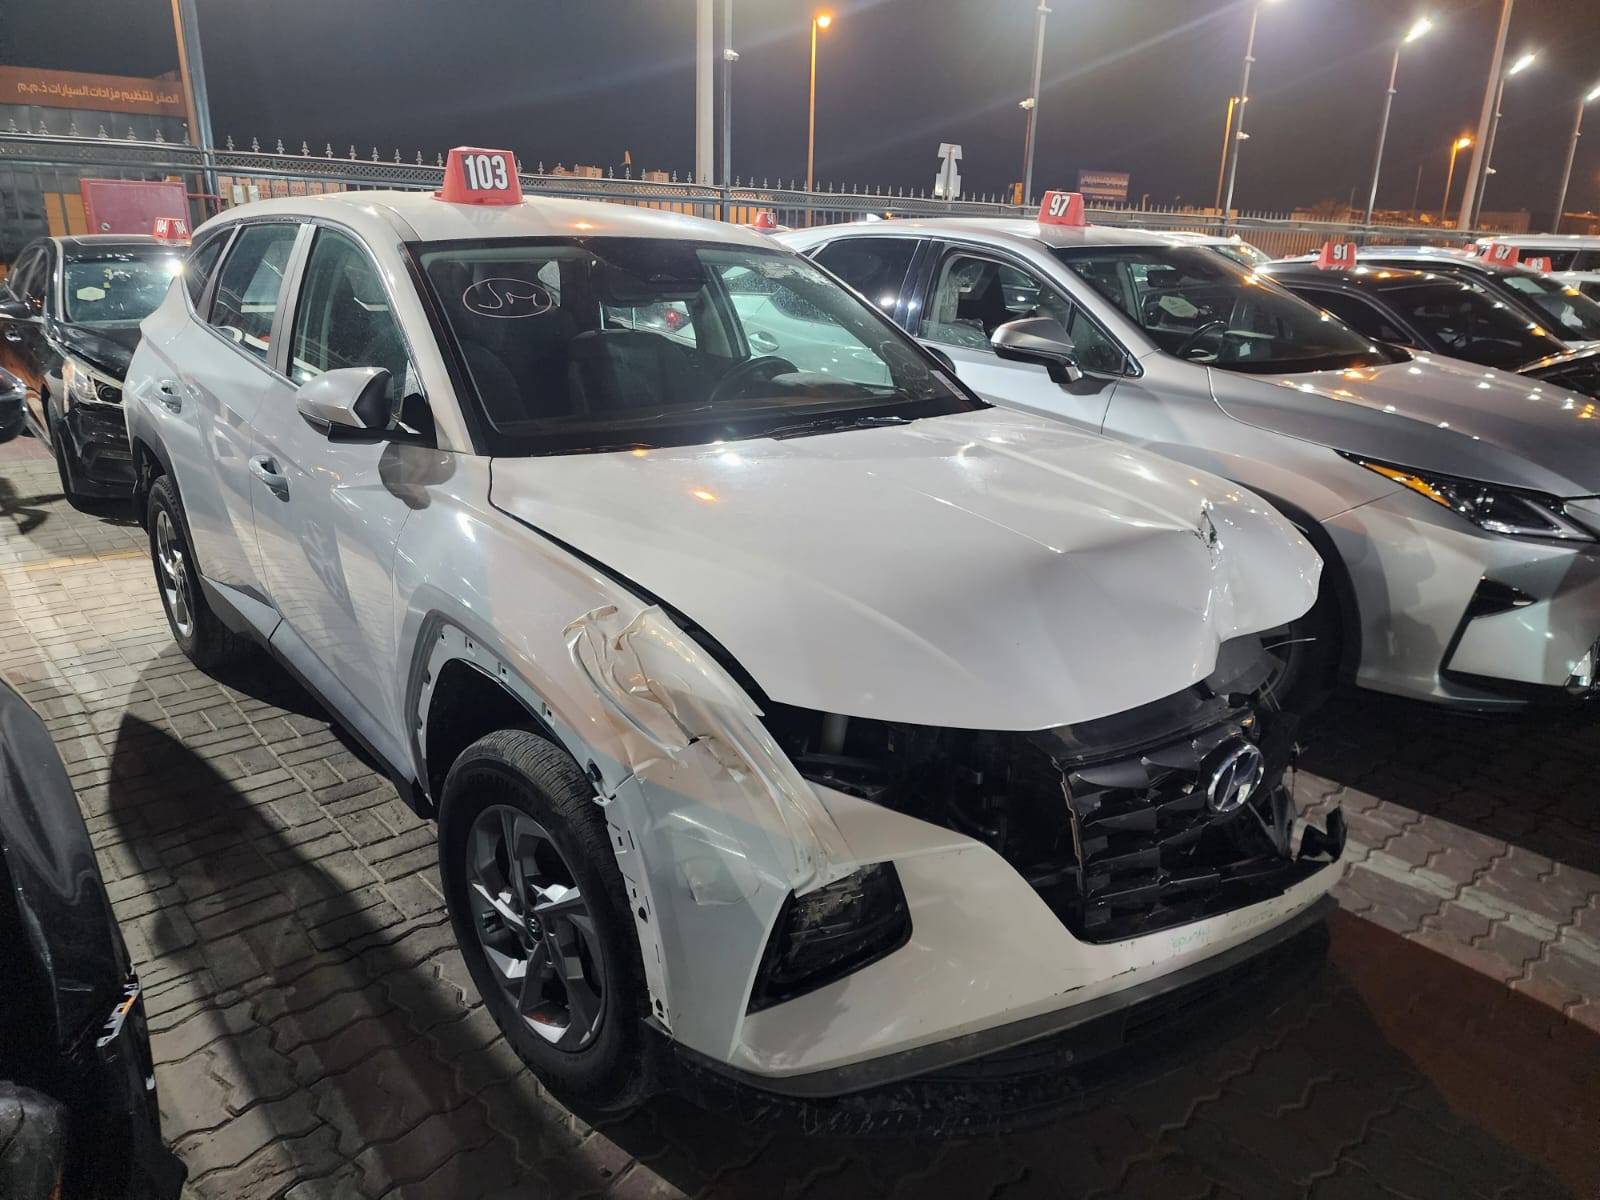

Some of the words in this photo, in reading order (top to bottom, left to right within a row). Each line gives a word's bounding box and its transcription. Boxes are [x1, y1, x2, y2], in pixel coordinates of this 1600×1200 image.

[48, 83, 89, 98] السيارات
[464, 154, 508, 190] 103
[1049, 194, 1071, 216] 97
[1333, 244, 1348, 260] 91
